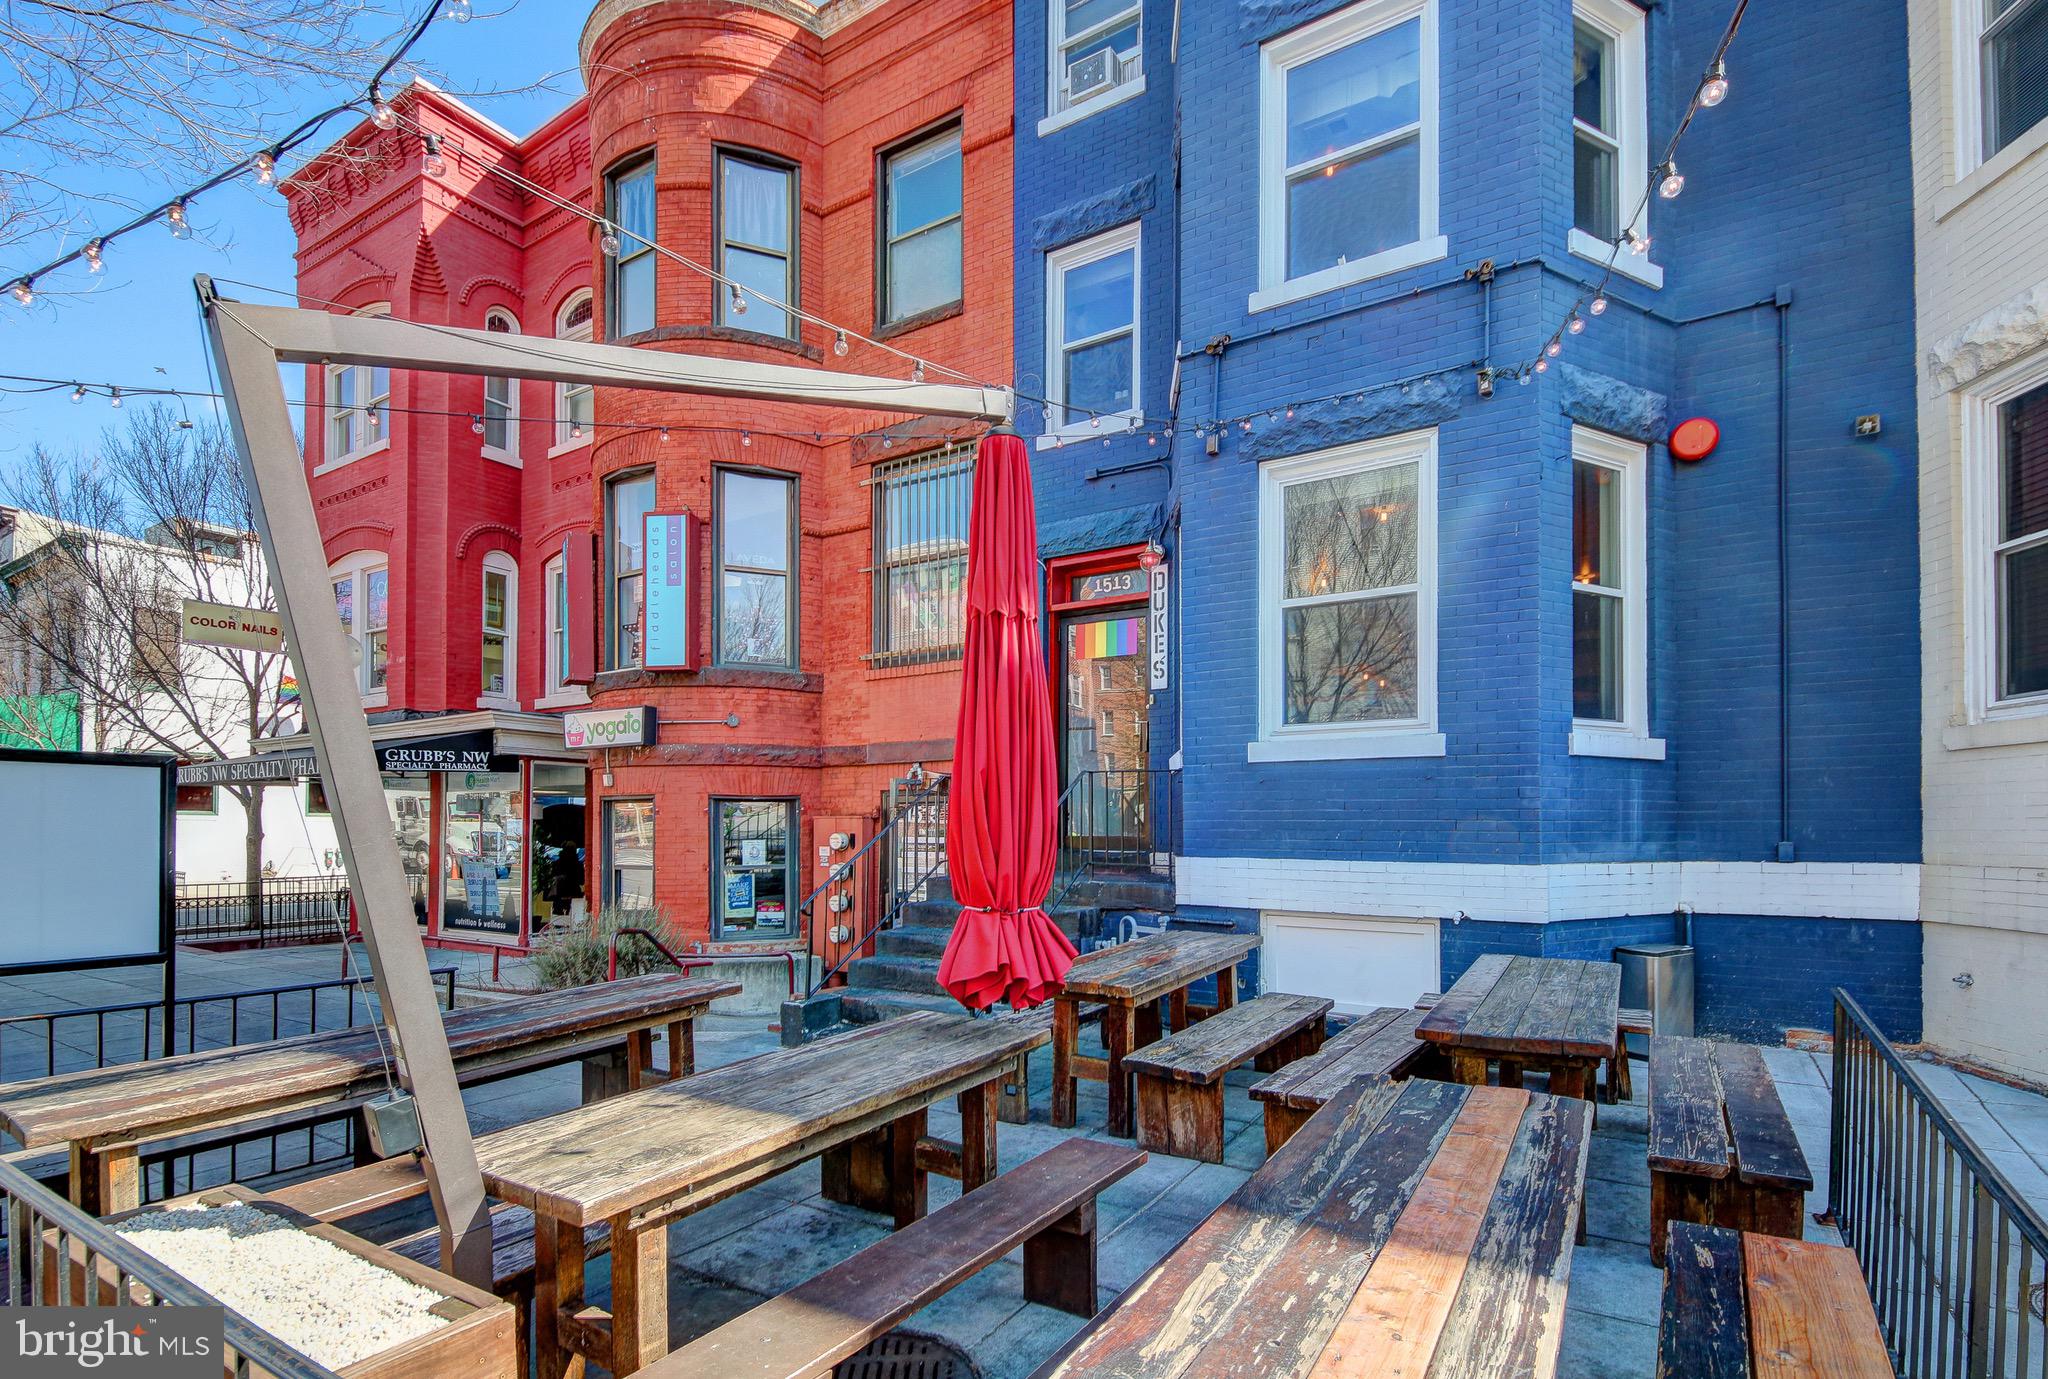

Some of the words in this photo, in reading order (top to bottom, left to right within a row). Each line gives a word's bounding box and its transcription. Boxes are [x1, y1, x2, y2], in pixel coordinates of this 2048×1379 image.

[669, 524, 678, 580] salon
[650, 526, 661, 650] fiddleheads
[1094, 575, 1131, 592] 1513
[190, 616, 236, 630] COLOR
[242, 623, 278, 636] NAILS
[586, 711, 641, 744] yogato
[385, 749, 456, 762] GRUBB'S
[462, 751, 490, 763] NW
[385, 761, 434, 769] SPECIALTY
[439, 762, 489, 770] PHARMACY
[177, 766, 208, 784] RUBB'S
[211, 765, 229, 781] NW
[231, 760, 285, 780] SPECIALTY
[478, 918, 483, 927] &
